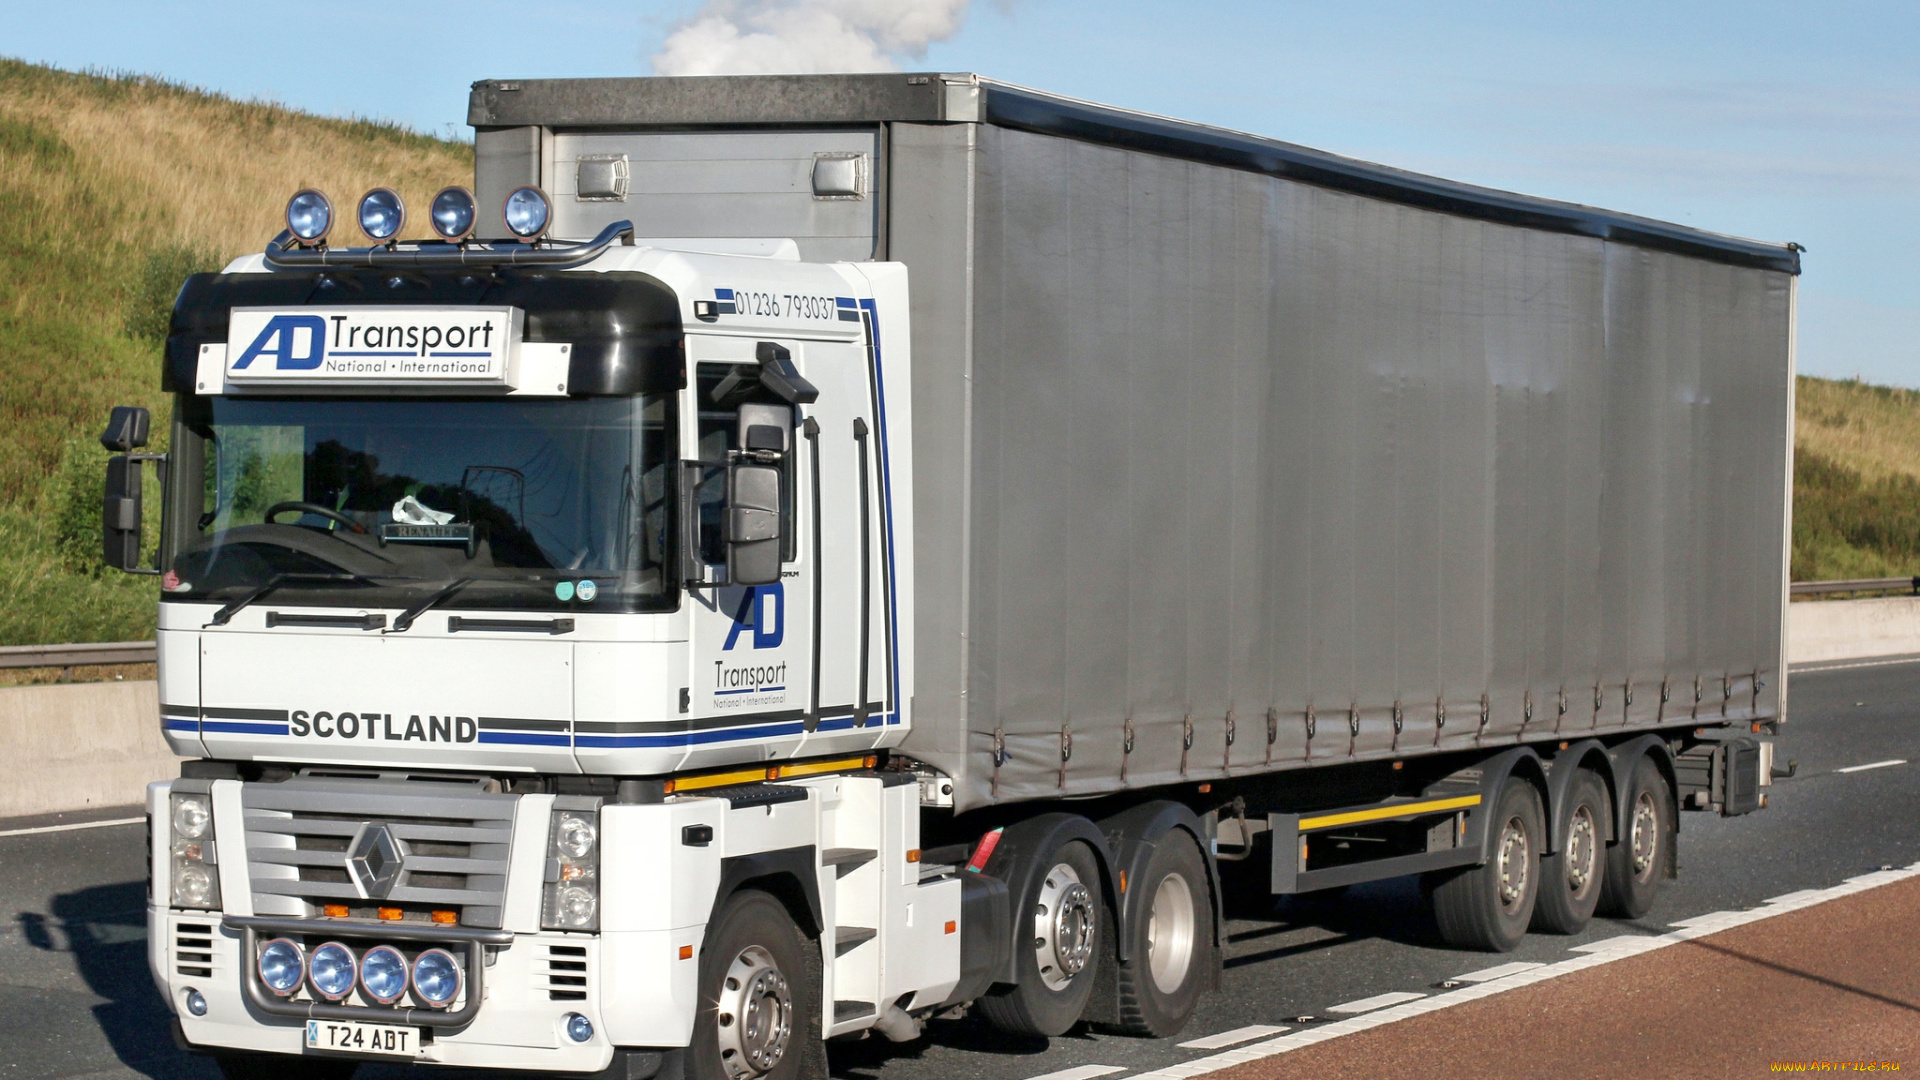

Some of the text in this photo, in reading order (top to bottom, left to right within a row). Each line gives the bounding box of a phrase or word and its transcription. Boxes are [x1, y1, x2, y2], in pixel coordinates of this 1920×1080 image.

[735, 291, 834, 320] 01236 793037
[231, 314, 327, 370] AD
[330, 315, 494, 357] Transport
[326, 359, 491, 374] National International
[398, 526, 456, 537] RENAULT
[722, 580, 784, 651] AD
[714, 660, 787, 693] Transport
[713, 694, 786, 709] National International
[291, 709, 477, 744] SCOTLAND
[327, 1025, 409, 1052] T24 ADT
